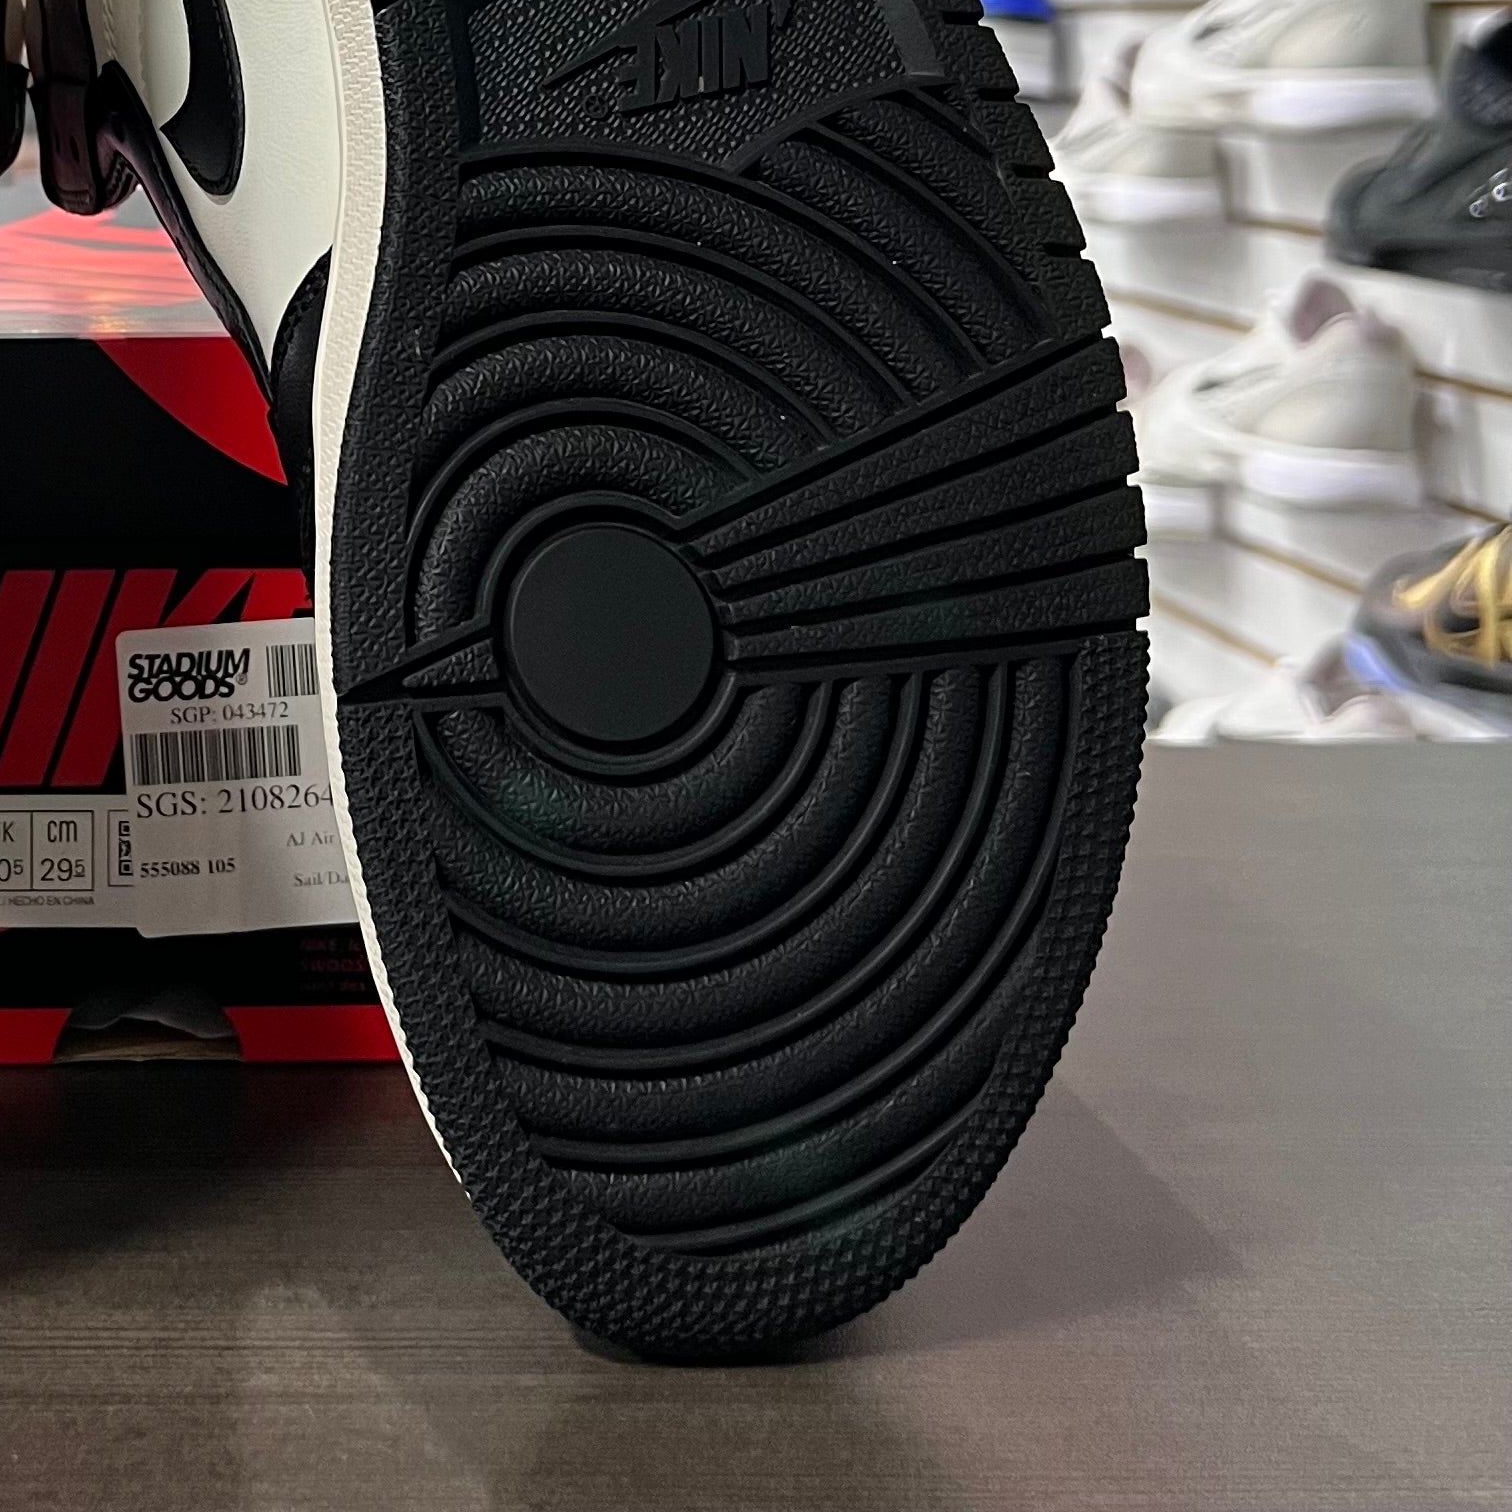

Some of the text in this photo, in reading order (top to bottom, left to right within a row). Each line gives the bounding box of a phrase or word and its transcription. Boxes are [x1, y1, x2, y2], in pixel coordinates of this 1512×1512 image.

[616, 3, 771, 115] NIKE
[127, 648, 251, 680] STADIUM
[127, 675, 236, 703] GOODS
[170, 701, 289, 725] SGP: 043472
[136, 790, 208, 819] SGS:
[140, 857, 236, 878] 555088 105
